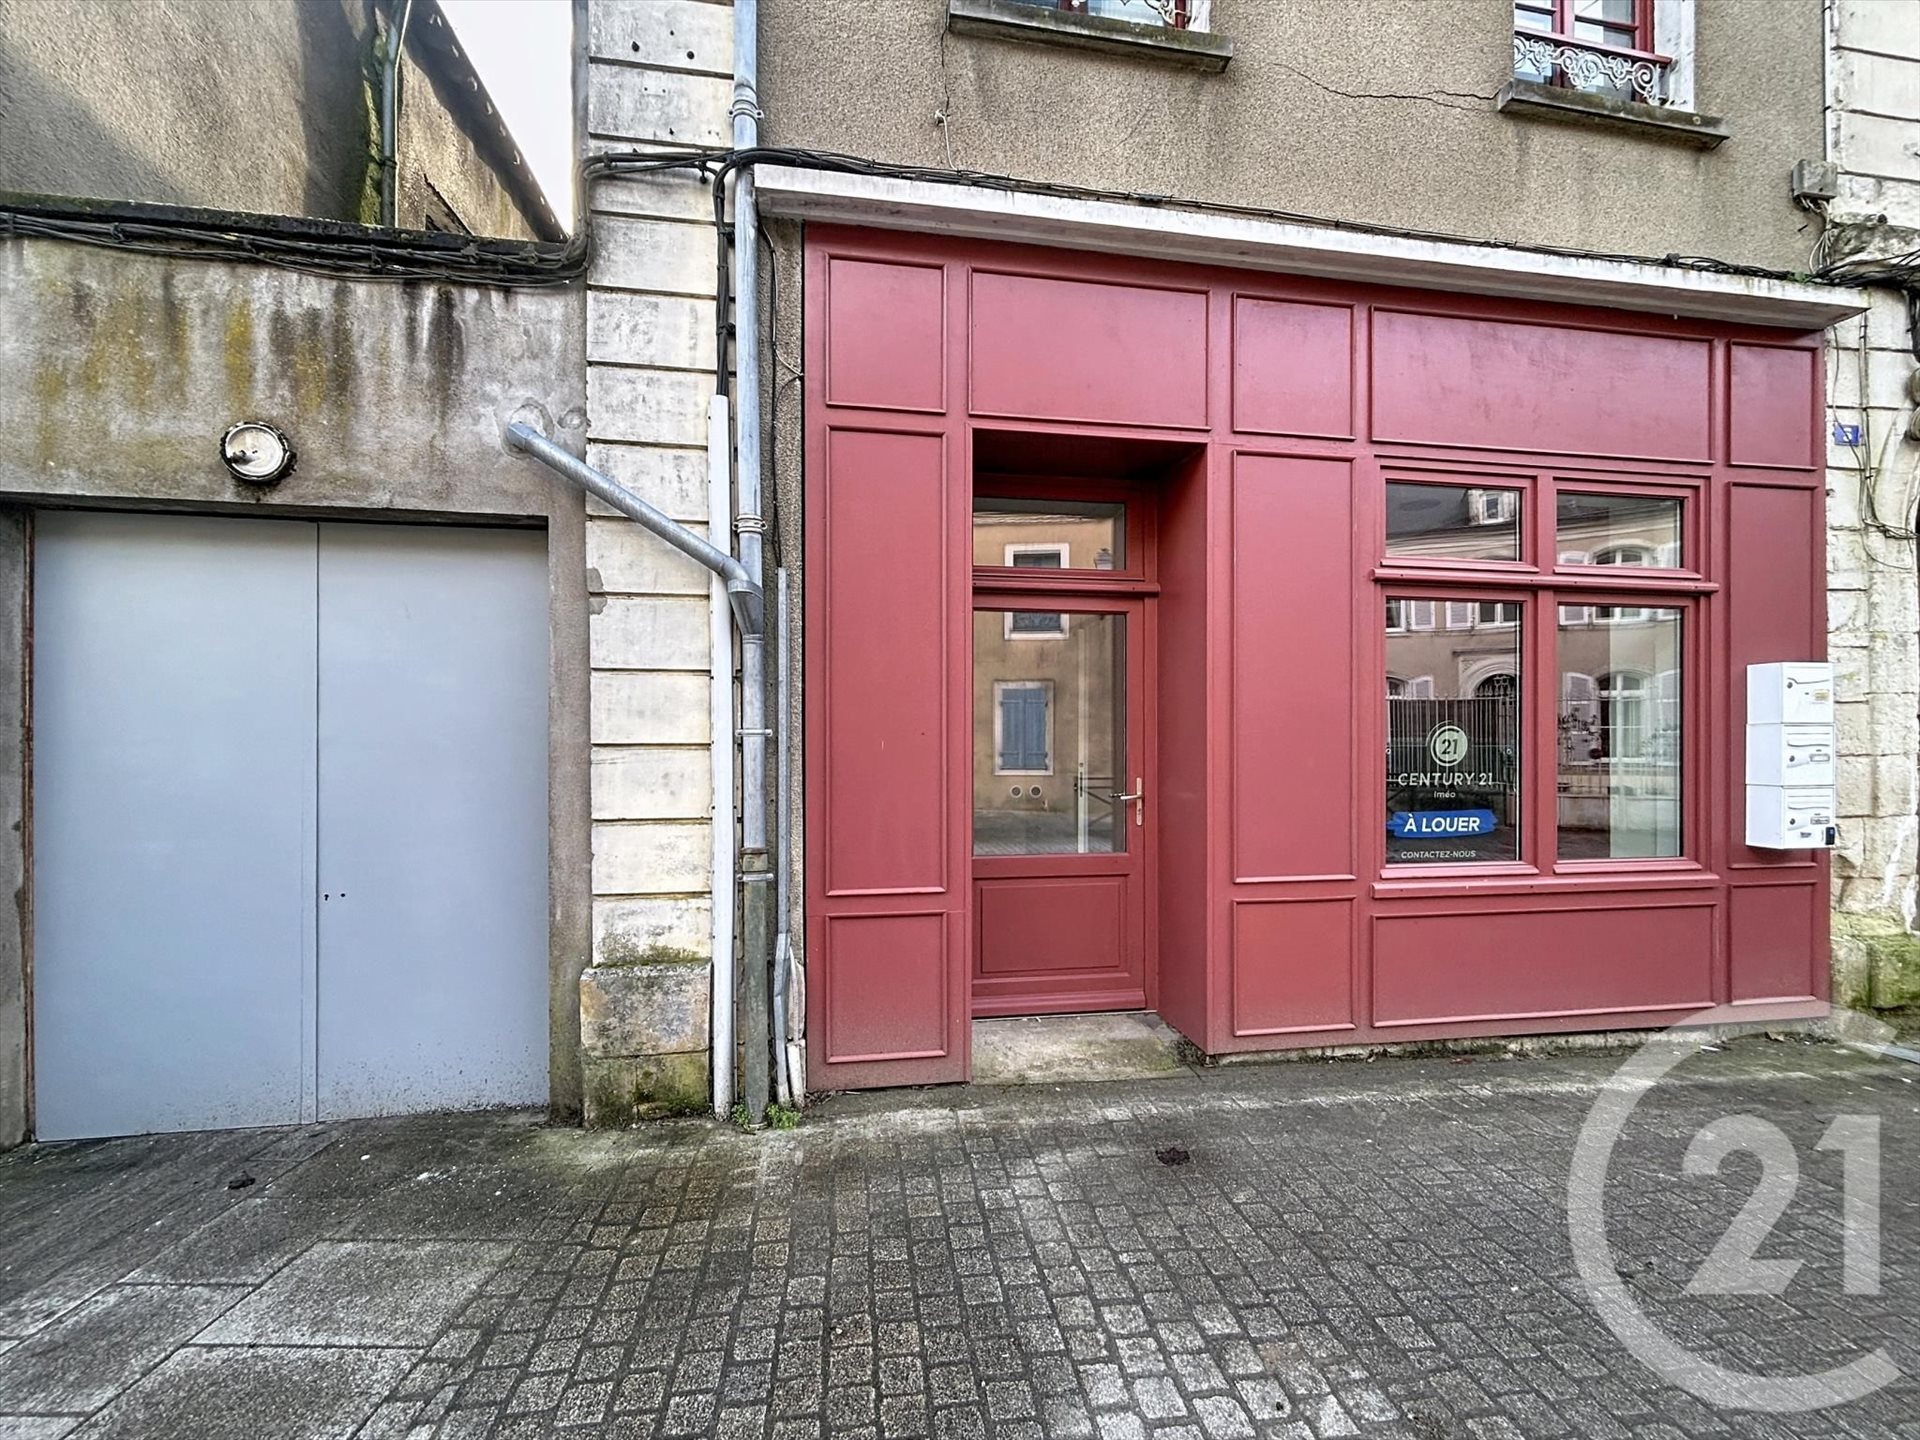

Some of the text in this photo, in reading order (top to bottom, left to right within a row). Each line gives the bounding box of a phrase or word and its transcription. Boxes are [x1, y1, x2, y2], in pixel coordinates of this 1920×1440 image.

[1441, 739, 1458, 754] 21
[1398, 773, 1493, 786] CENTURY 21
[1404, 814, 1480, 832] À LOUER
[1401, 850, 1476, 859] CONTACTEZ-NOUS
